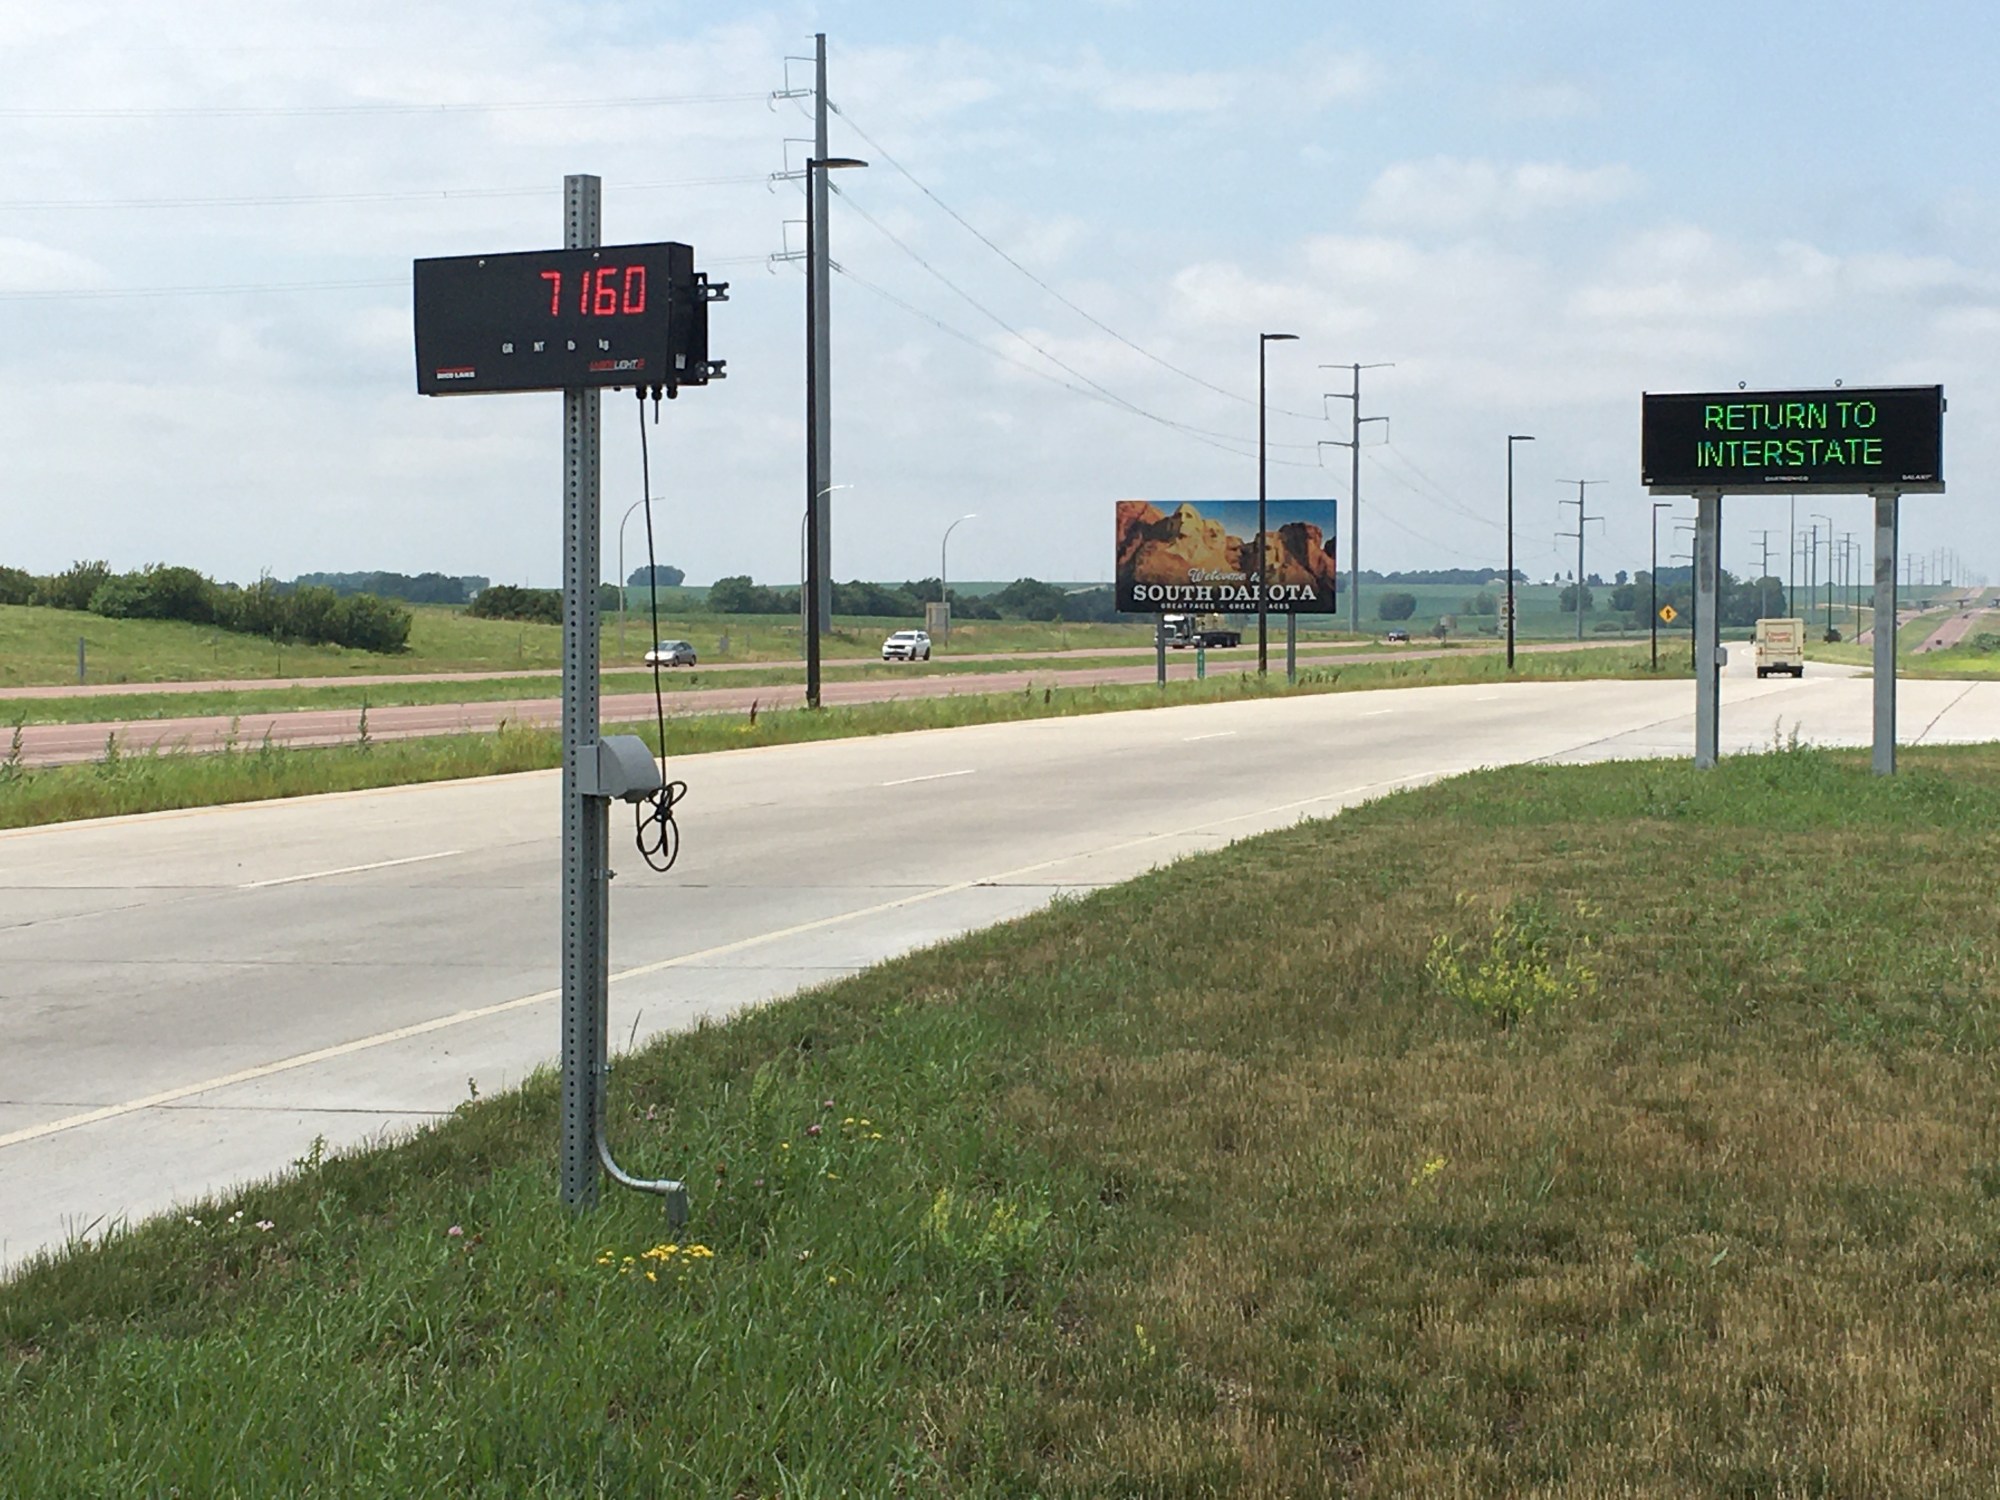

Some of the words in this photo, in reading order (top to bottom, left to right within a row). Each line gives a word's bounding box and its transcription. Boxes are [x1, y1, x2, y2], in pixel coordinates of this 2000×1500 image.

[540, 264, 646, 317] 7160
[1704, 402, 1827, 431] RETURN
[1835, 401, 1877, 429] TO
[1696, 437, 1883, 468] INTERSTATE
[1188, 568, 1247, 583] Welcome
[1133, 584, 1213, 601] SOUTH
[1219, 584, 1317, 601] DAKOTA
